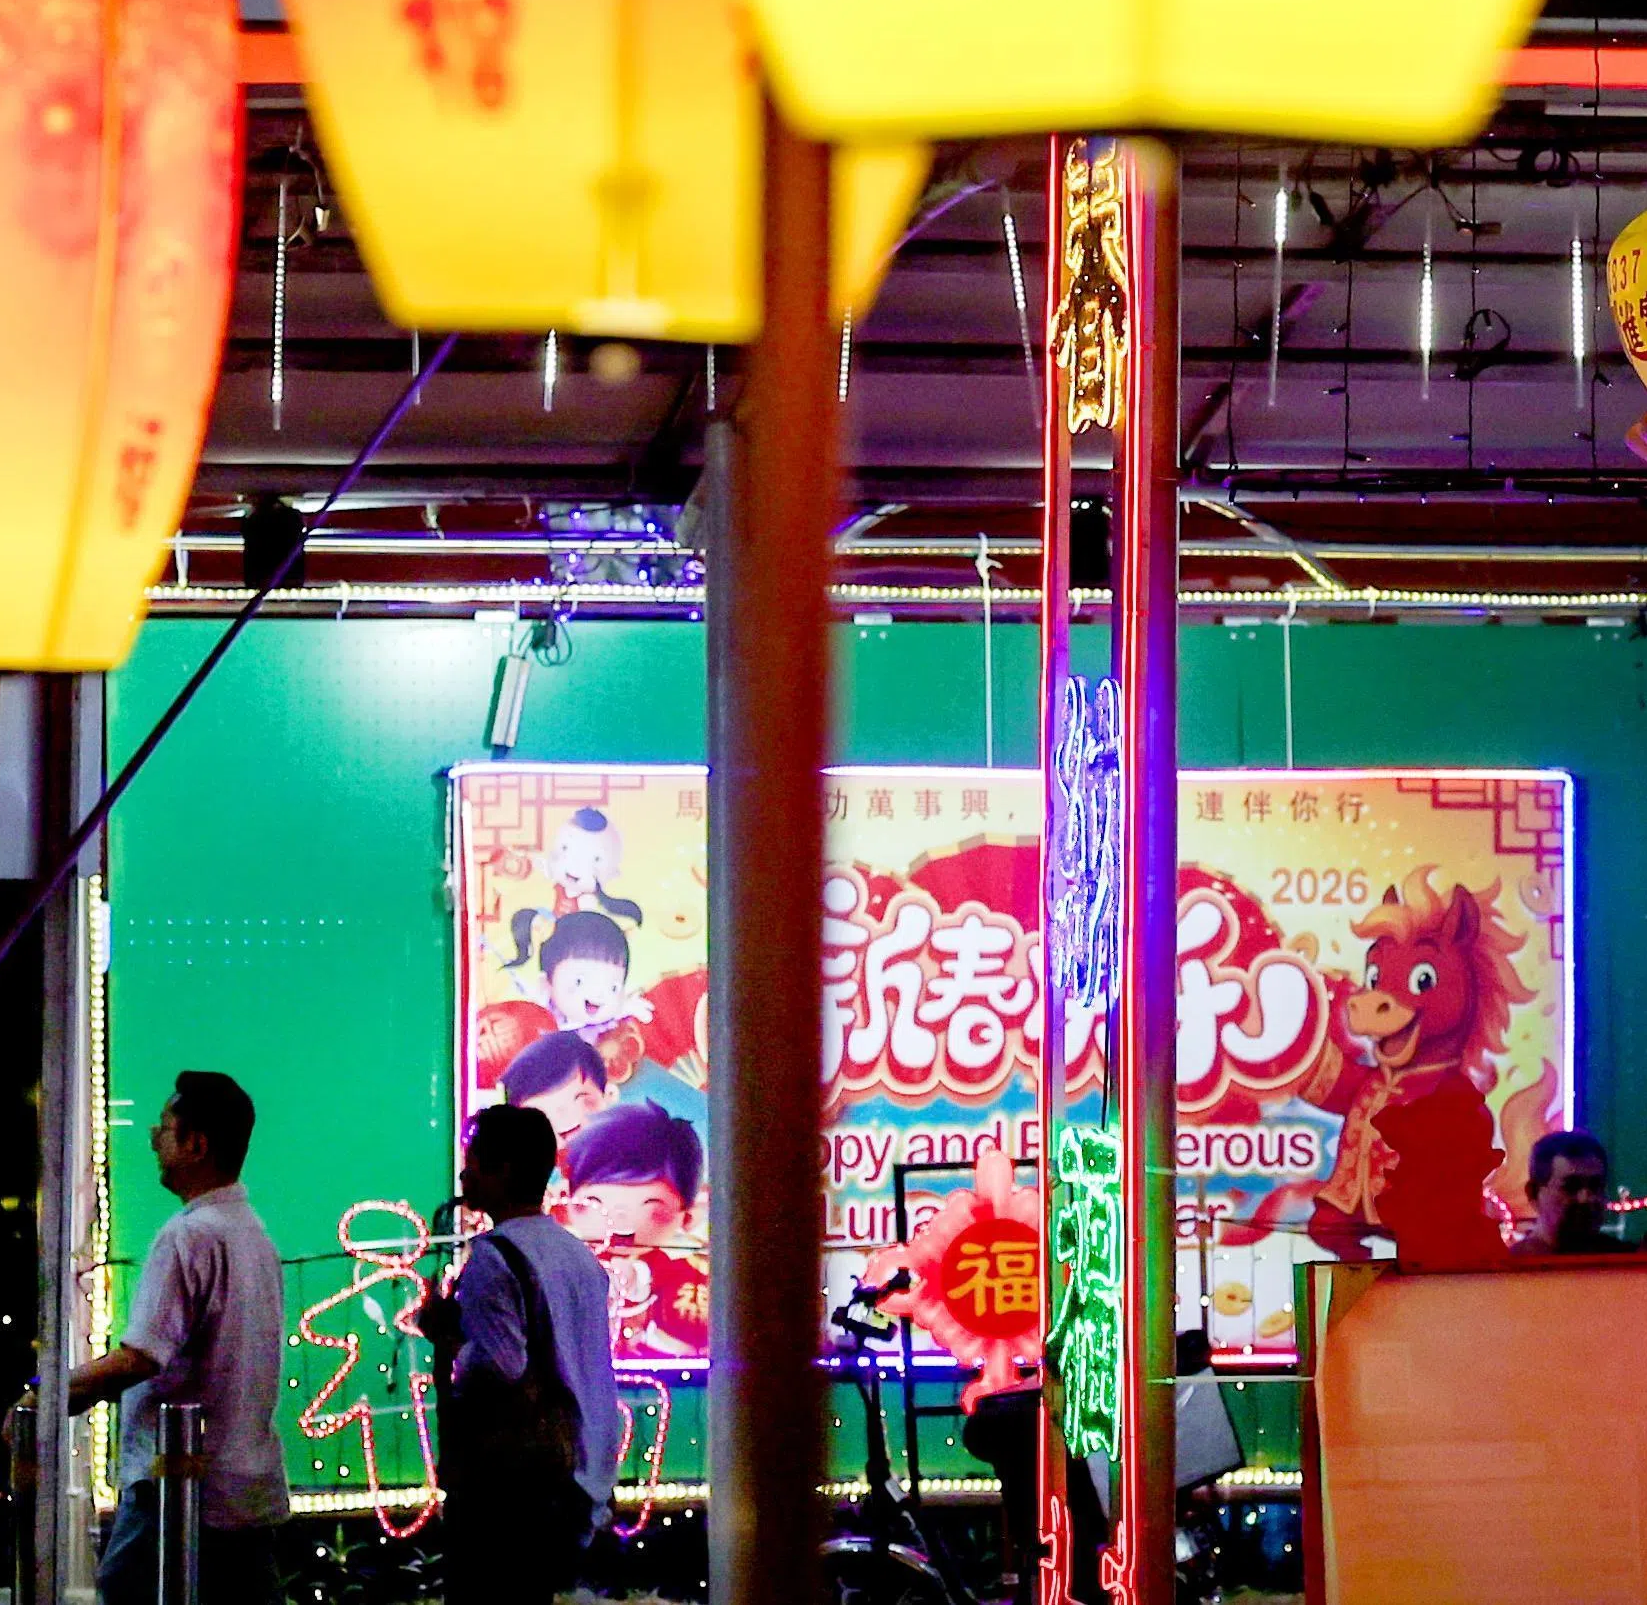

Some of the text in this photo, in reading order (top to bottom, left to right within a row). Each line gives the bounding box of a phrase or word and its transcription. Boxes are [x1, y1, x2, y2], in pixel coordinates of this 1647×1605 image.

[1270, 867, 1370, 905] 2026
[821, 1128, 890, 1182] ppy
[907, 1109, 1002, 1163] and
[825, 1197, 944, 1241] Luna
[947, 1240, 1039, 1318] 福
